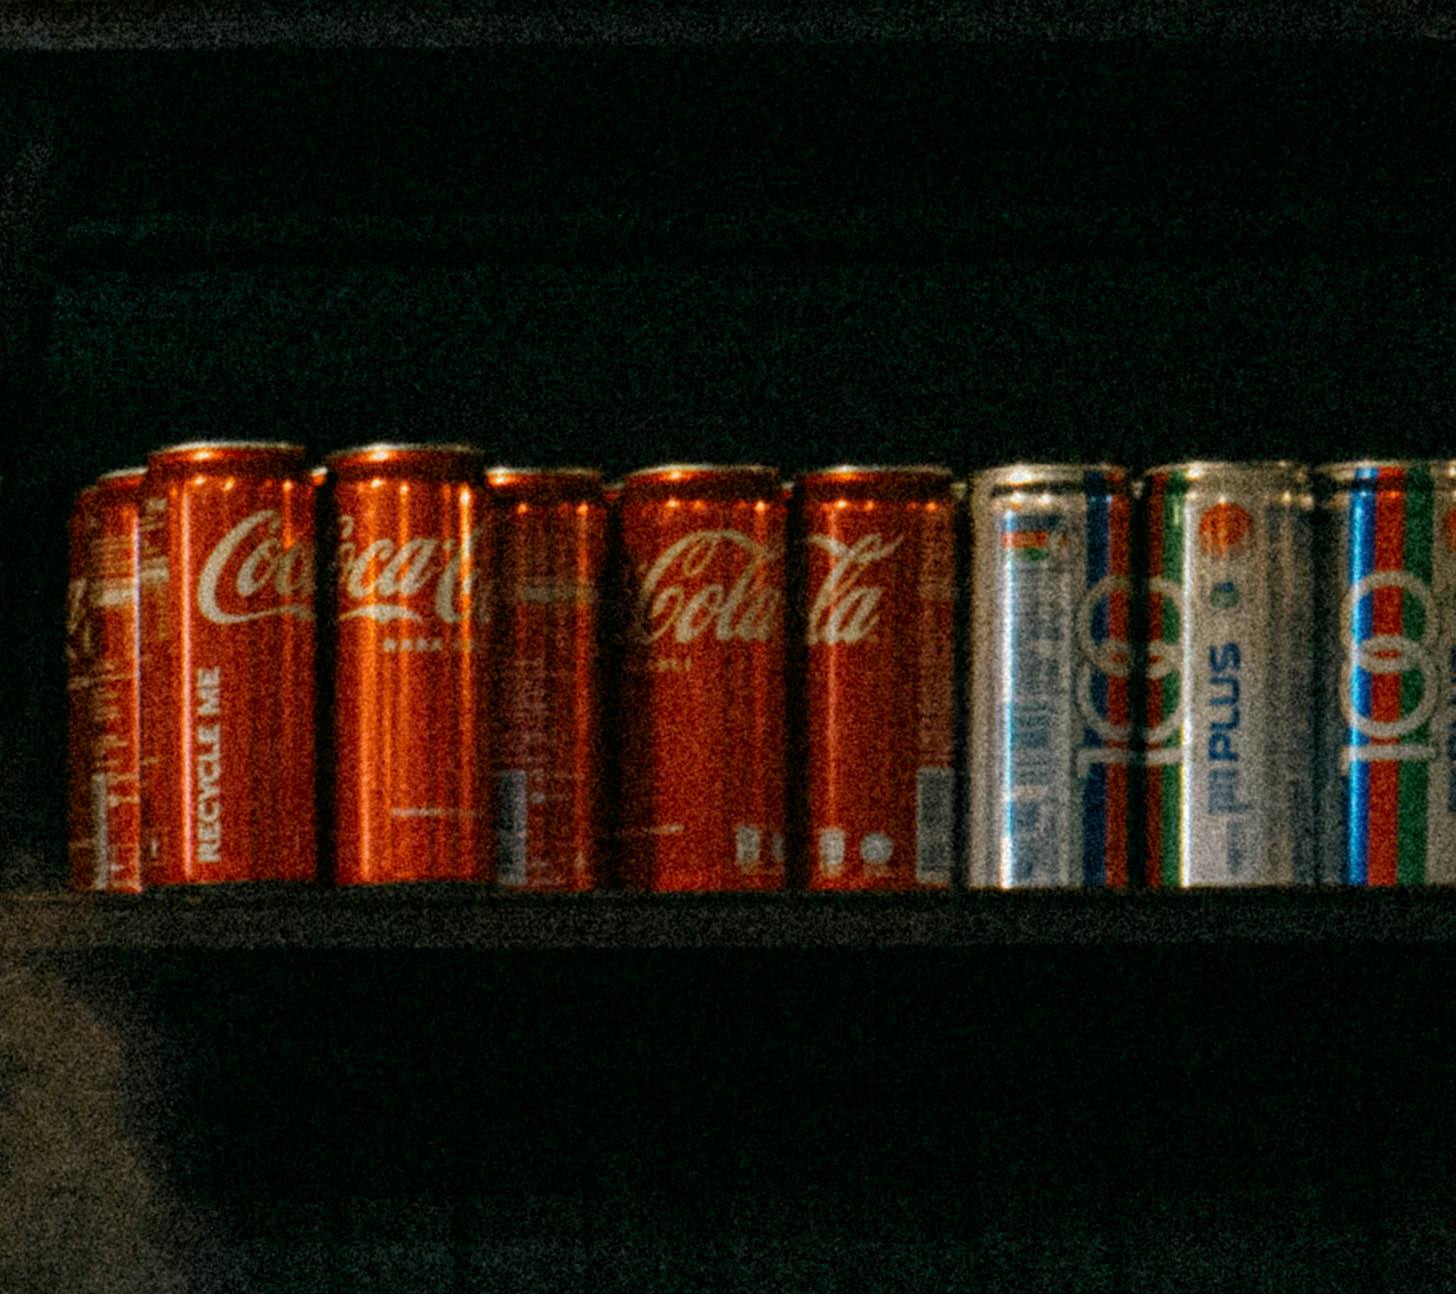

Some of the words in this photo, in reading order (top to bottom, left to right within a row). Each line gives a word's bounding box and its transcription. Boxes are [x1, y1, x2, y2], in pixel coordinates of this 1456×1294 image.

[196, 666, 222, 716] ME
[1208, 641, 1242, 763] PLUS
[196, 724, 222, 863] RECYCLE
